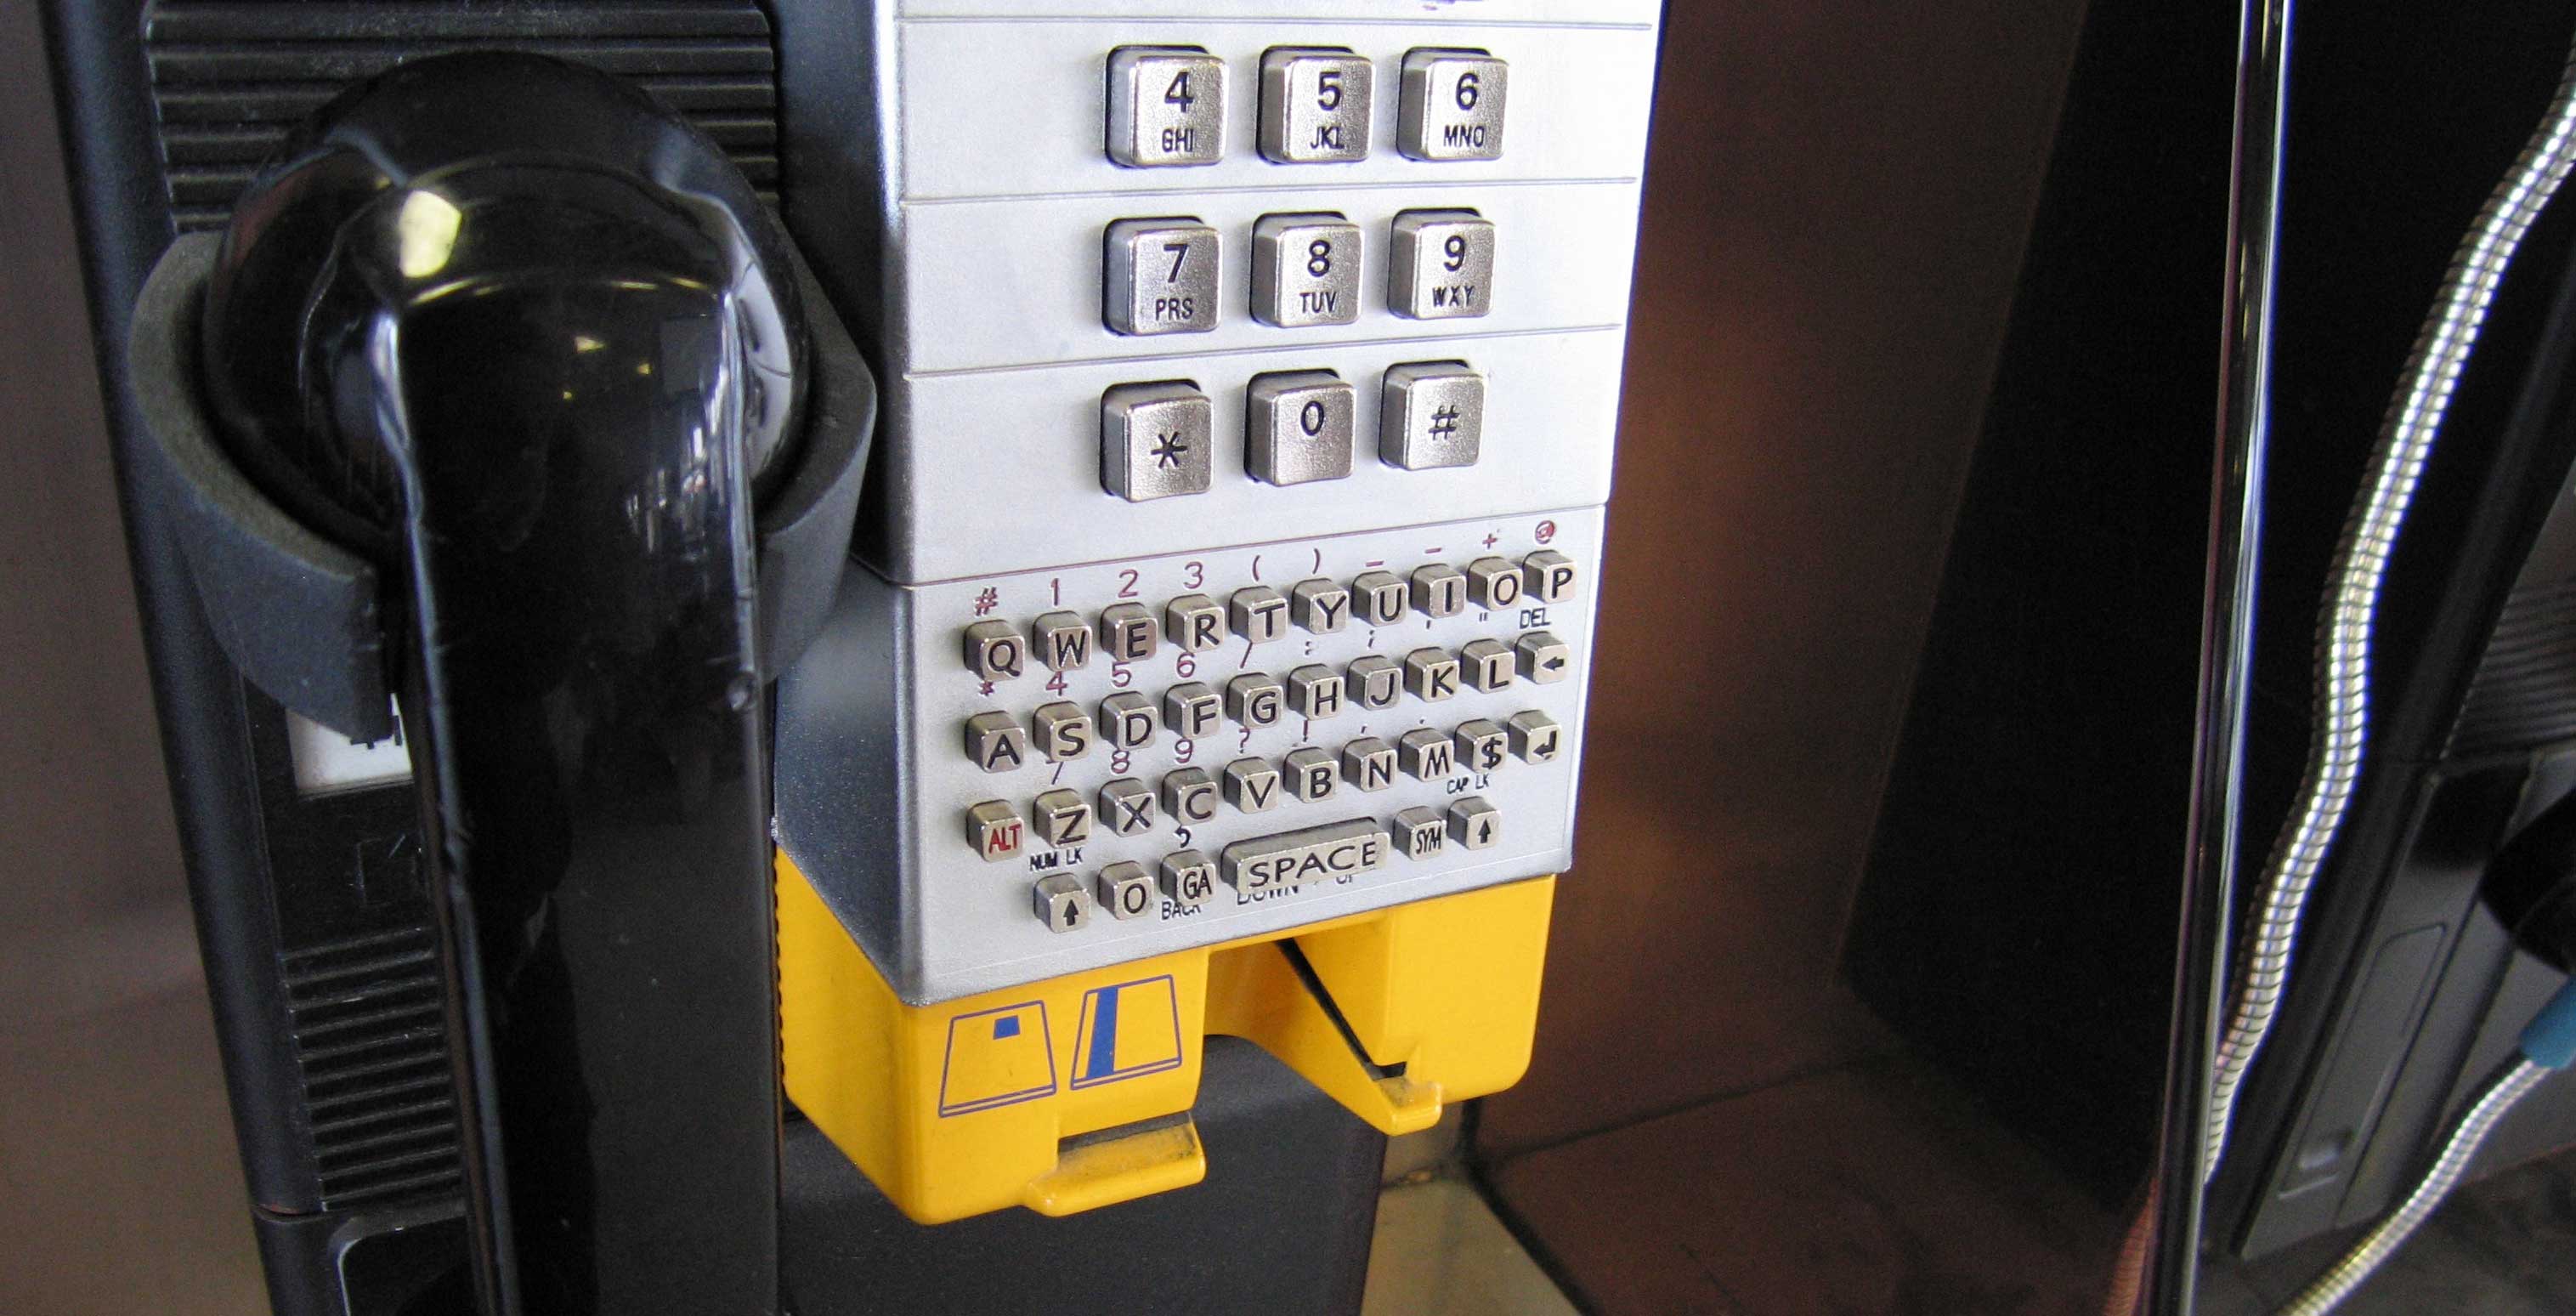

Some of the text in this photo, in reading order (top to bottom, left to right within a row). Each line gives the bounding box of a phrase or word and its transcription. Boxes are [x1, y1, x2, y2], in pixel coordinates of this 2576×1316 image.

[1163, 71, 1195, 113] 4
[1316, 70, 1342, 111] 5
[1455, 71, 1479, 111] 6
[1161, 126, 1194, 154] GHI
[1310, 125, 1345, 150] JKL
[1443, 123, 1486, 147] MNO
[1163, 242, 1190, 284] 7
[1307, 239, 1330, 278] 8
[1443, 235, 1465, 272] 9
[1154, 298, 1194, 321] PRS
[1299, 291, 1338, 314] TUV
[1432, 286, 1474, 307] WXY
[1299, 400, 1325, 436] 0
[1428, 404, 1461, 440] #
[975, 587, 998, 615] #
[1050, 578, 1059, 605] 1
[1118, 569, 1139, 598] 2
[1183, 562, 1203, 589] 3
[1252, 554, 1260, 581] (
[1312, 548, 1321, 575] )
[1481, 533, 1498, 549] +
[988, 567, 1573, 677] Q W E R T Y U I O P
[1519, 607, 1552, 630] DEL
[1045, 671, 1068, 696] 4
[1111, 661, 1133, 687] 5
[1176, 652, 1196, 678] 6
[987, 658, 1509, 769] A S D F G H J K L
[1111, 749, 1130, 774] 8
[1174, 738, 1193, 763] 9
[988, 736, 1503, 854] ALT Z X C V B N M $
[1447, 774, 1490, 795] CAP LK
[1029, 846, 1083, 871] NUM LK
[1183, 868, 1213, 899] GA
[1248, 841, 1376, 888] SPACE
[1415, 825, 1442, 855] SYM
